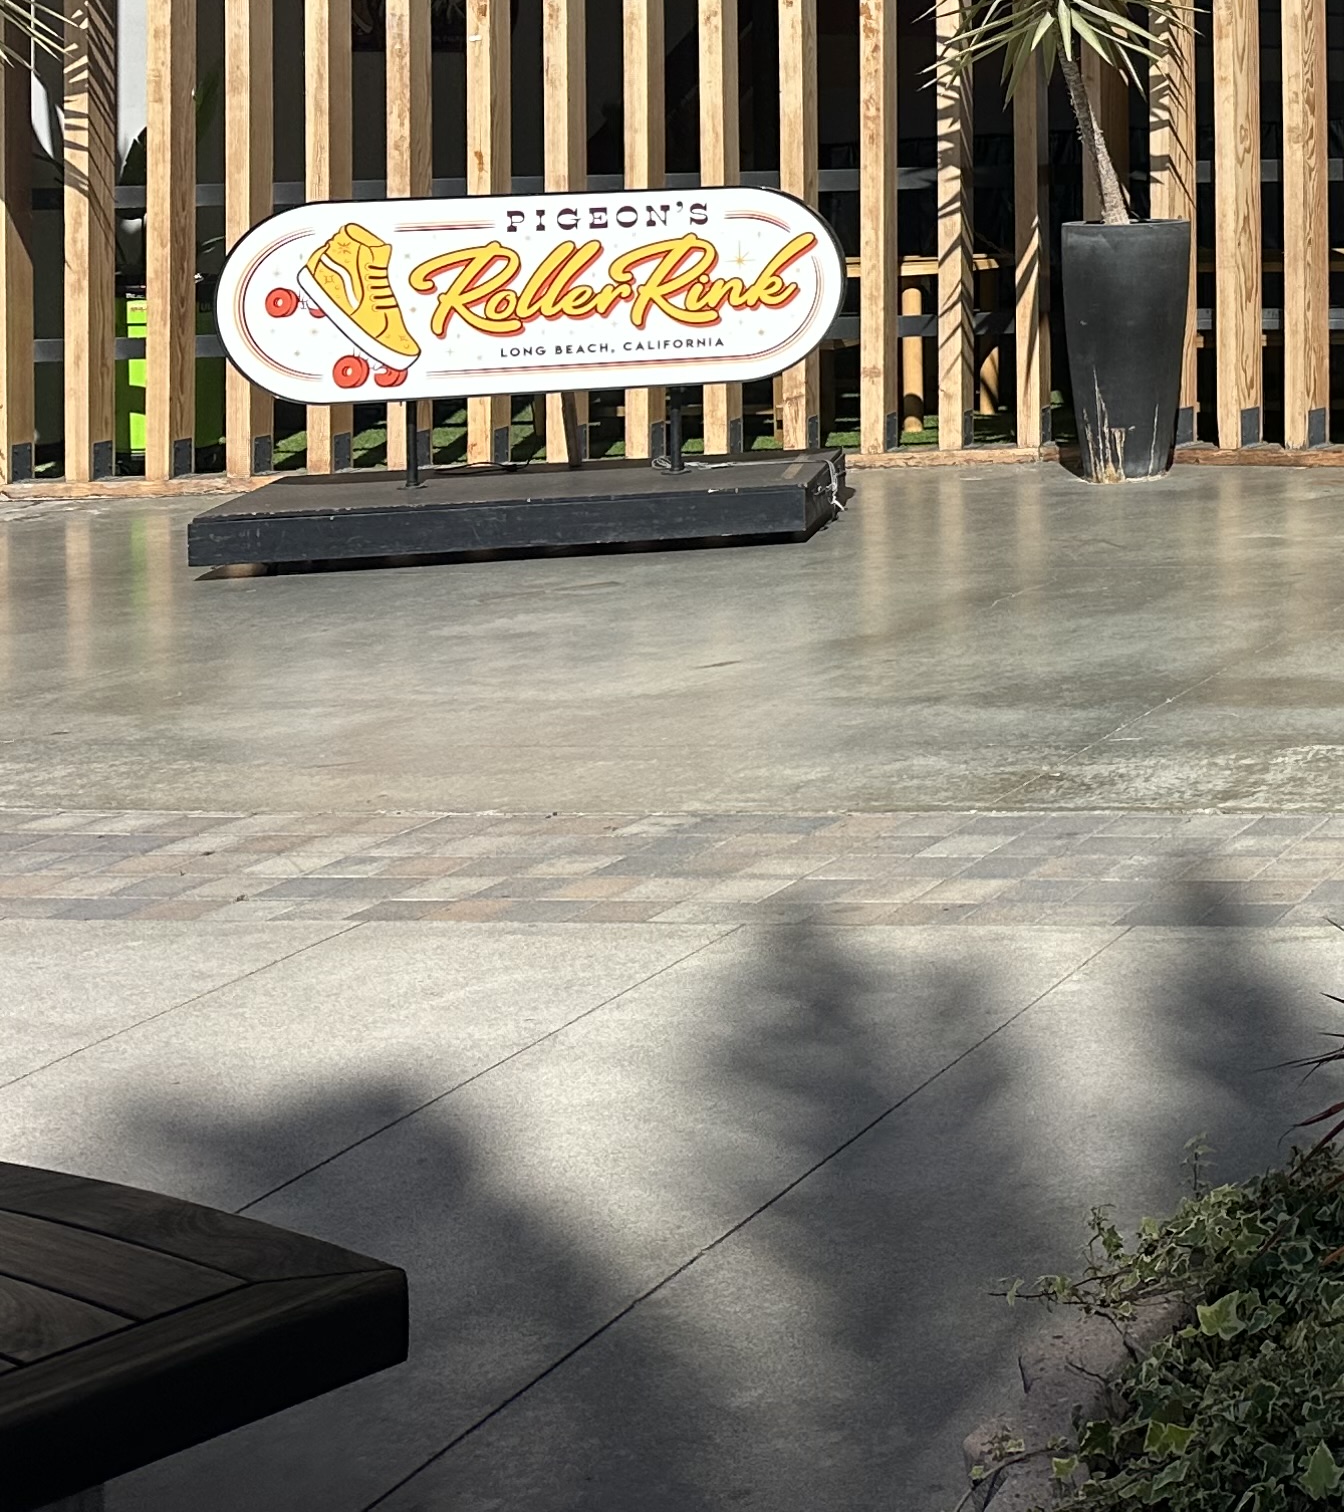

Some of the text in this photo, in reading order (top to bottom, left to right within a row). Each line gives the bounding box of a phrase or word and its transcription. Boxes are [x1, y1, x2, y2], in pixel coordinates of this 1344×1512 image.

[506, 201, 709, 233] PIGEON'S
[408, 232, 819, 339] Roller Rink
[500, 337, 725, 358] LONG BEACH, CALIFORNIA
